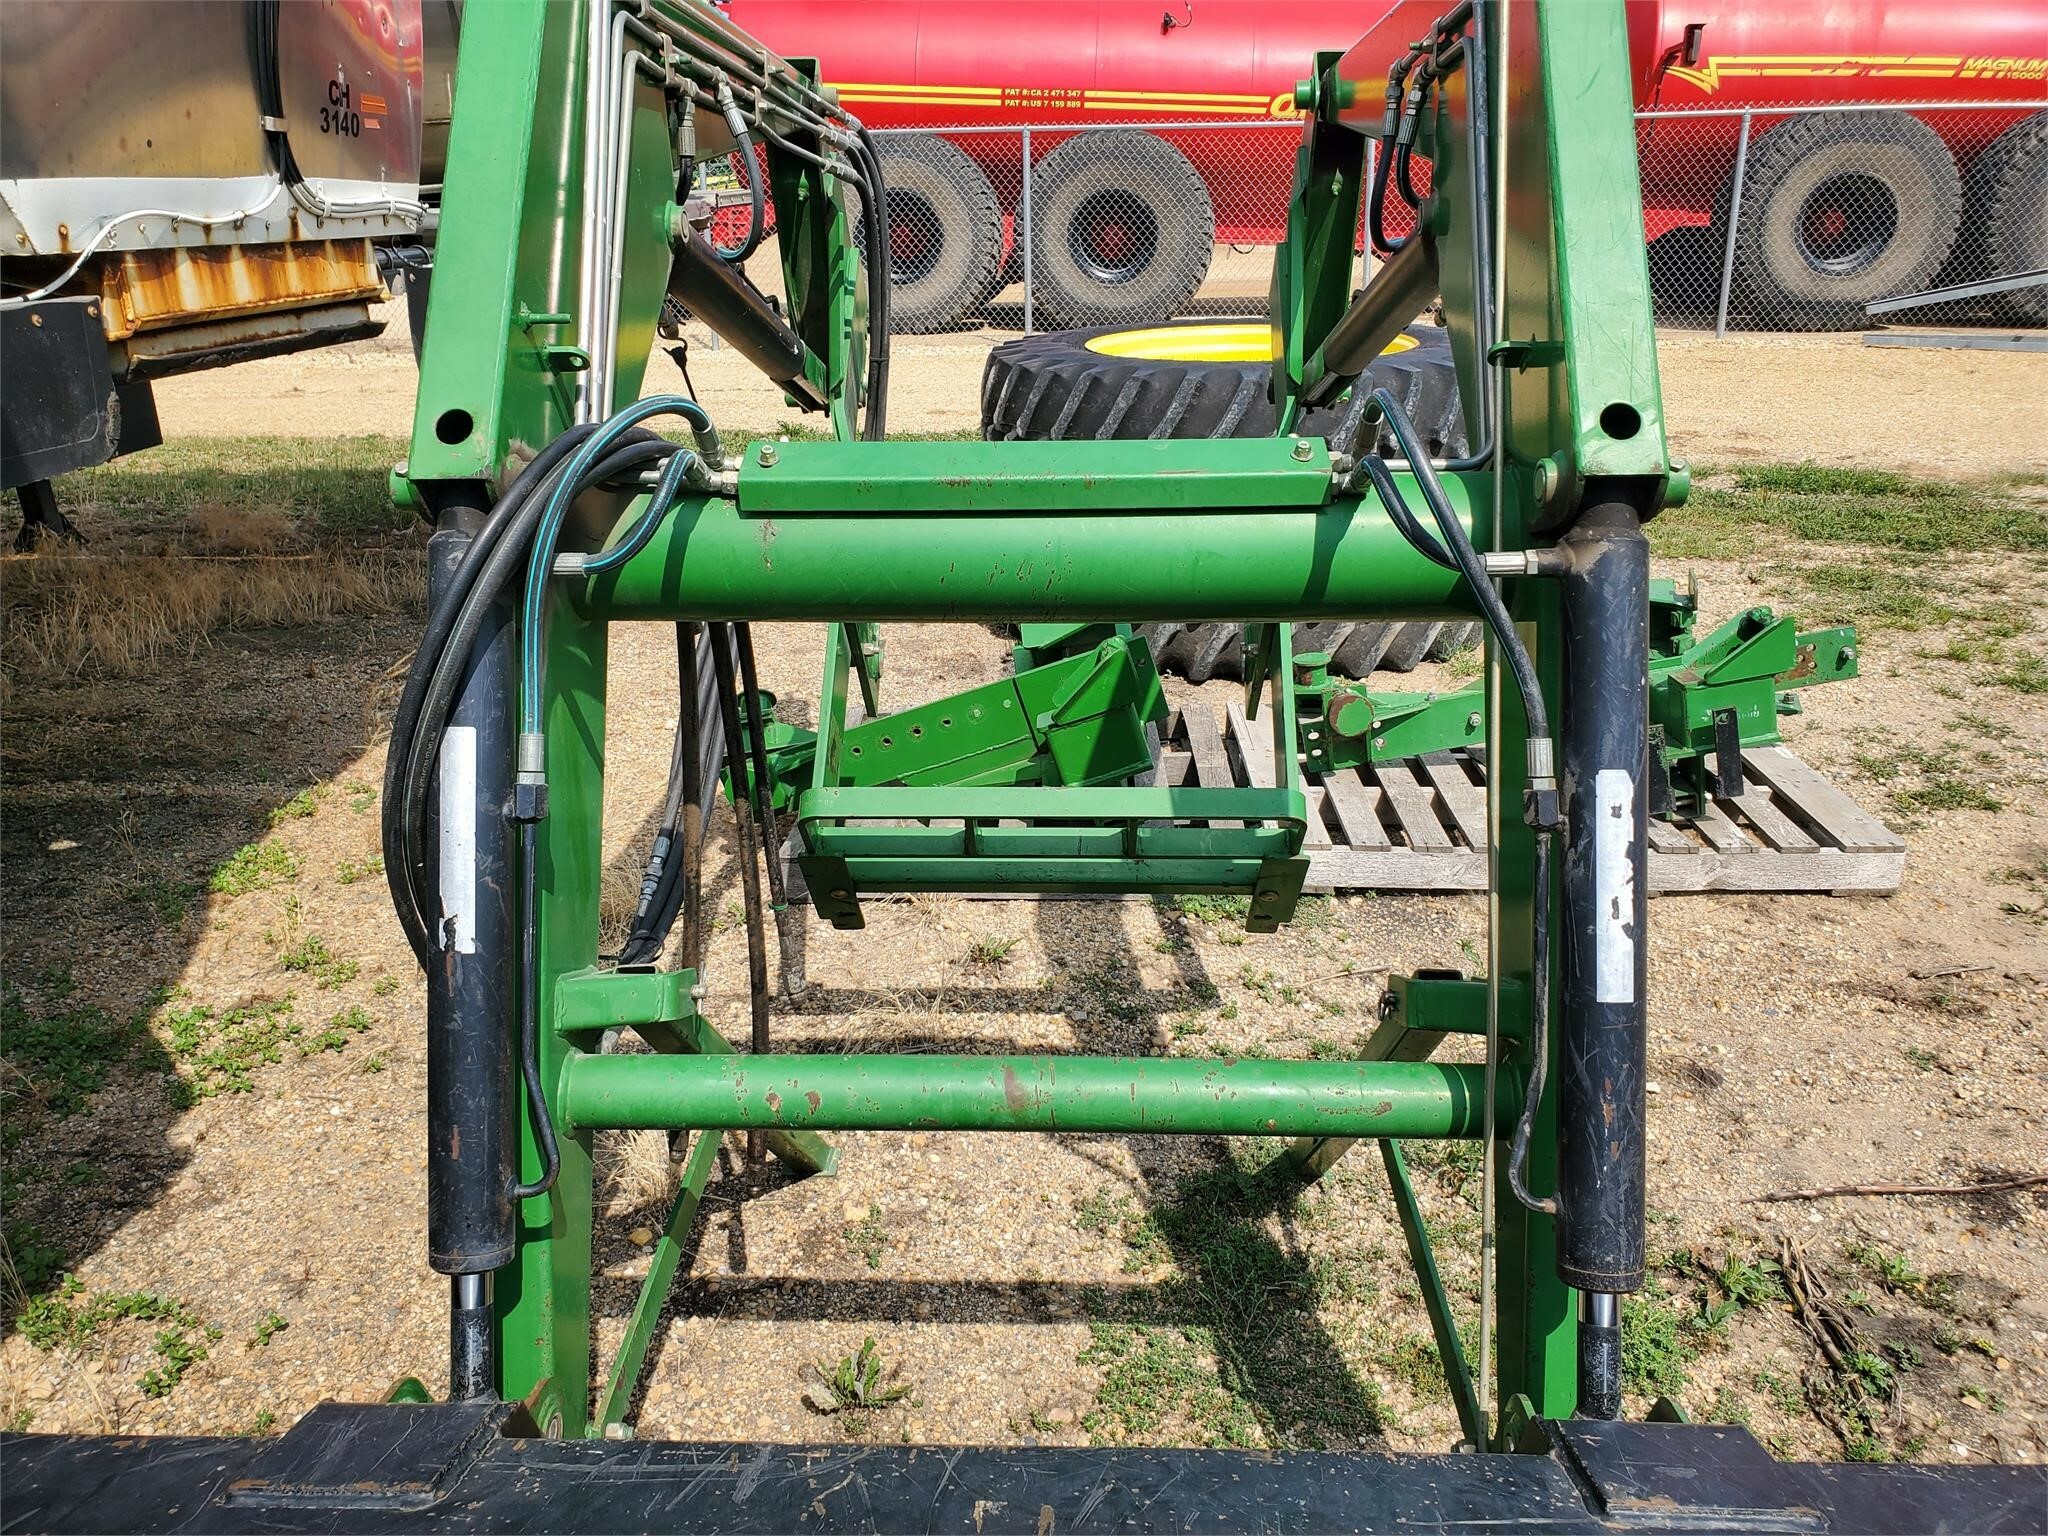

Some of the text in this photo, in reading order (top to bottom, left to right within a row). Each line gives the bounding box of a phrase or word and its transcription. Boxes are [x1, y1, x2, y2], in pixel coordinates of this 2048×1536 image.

[1963, 57, 2048, 71] MAGNUM
[2007, 71, 2044, 80] 15000
[328, 80, 350, 109] CH
[1004, 88, 1020, 96] PAT
[1050, 89, 1065, 97] 471
[1066, 89, 1082, 97] 347
[1004, 99, 1020, 107] PAT
[1050, 100, 1065, 108] 159
[320, 107, 360, 138] 3140
